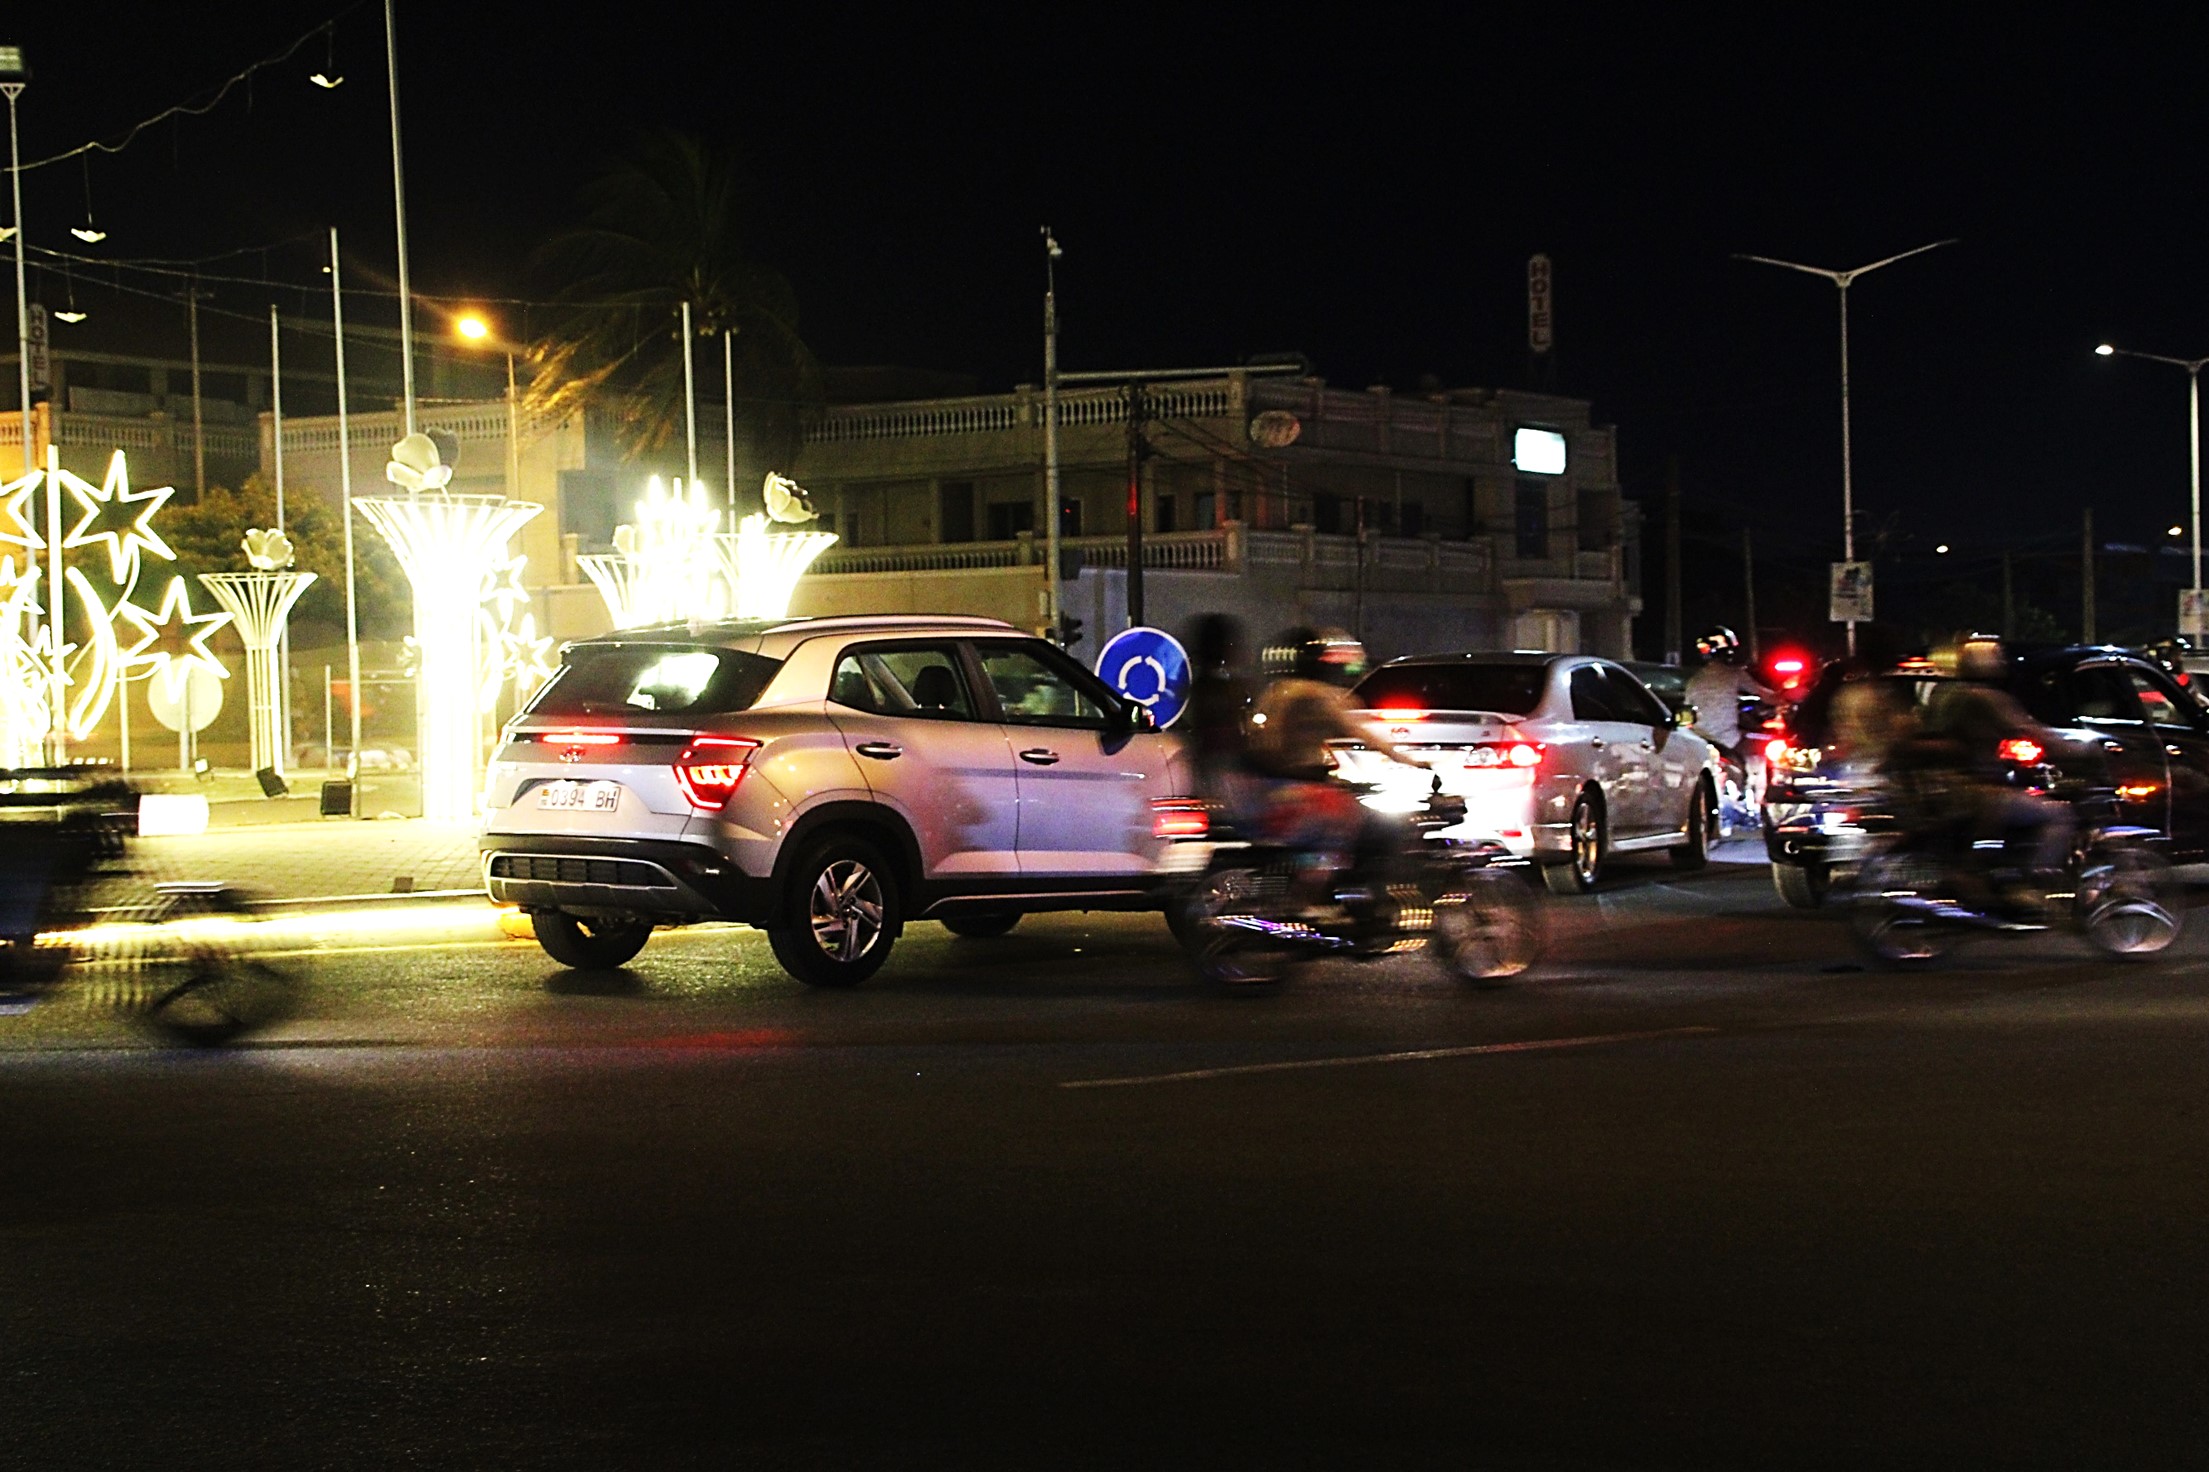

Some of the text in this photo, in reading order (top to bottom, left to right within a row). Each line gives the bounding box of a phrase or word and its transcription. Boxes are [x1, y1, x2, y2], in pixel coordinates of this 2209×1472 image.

[1531, 261, 1549, 345] HOTEL
[551, 788, 585, 807] 0394
[595, 789, 617, 808] BH
